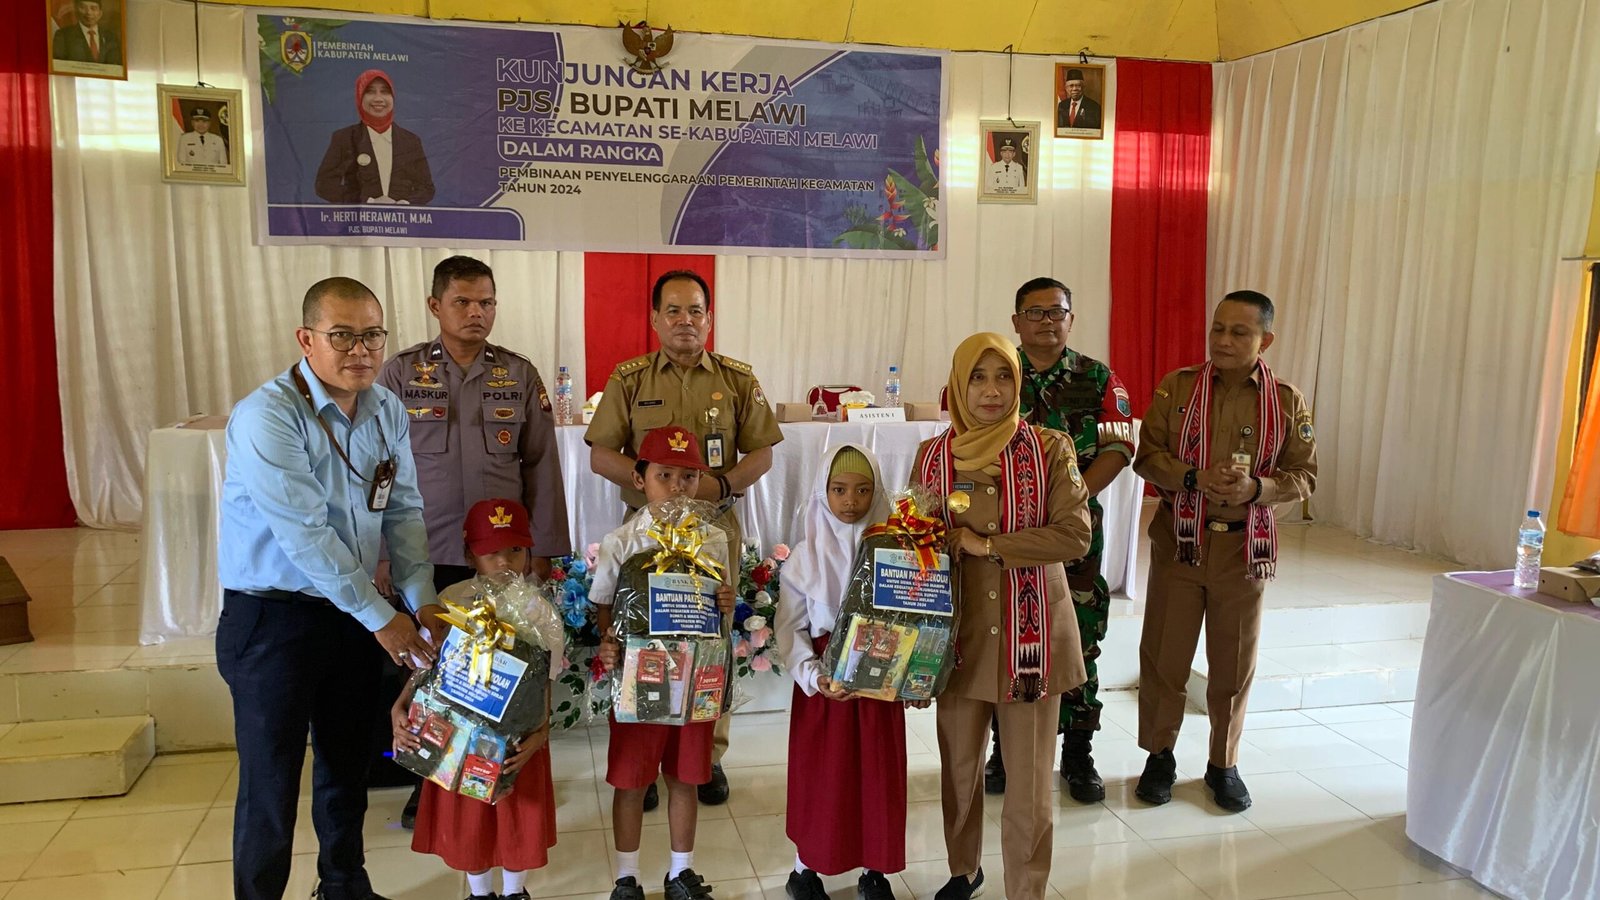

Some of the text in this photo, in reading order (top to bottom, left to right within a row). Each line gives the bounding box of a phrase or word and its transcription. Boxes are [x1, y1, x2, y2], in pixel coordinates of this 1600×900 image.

[318, 42, 374, 51] PEMERINTAH
[318, 50, 408, 62] KABUPATEN MELAWI
[496, 58, 793, 97] KUNJUNGAN KERJA
[496, 88, 806, 126] PJS. BUPATI MELAWI
[498, 116, 878, 150] KE KECAMATAN SE-KABUPATEN MELAWI
[504, 140, 661, 162] DALAM RANGKA
[500, 167, 875, 192] PEMBINAAN PENYELENGGARAAN PEMERINTAH KECAMATAN
[500, 182, 582, 195] TAHUN 2024
[320, 211, 331, 222] Ir.
[333, 212, 357, 222] HERTI
[410, 213, 432, 224] M.MA
[405, 389, 448, 400] MASKUR
[483, 392, 522, 400] POLRI
[881, 568, 908, 579] BANTUAN
